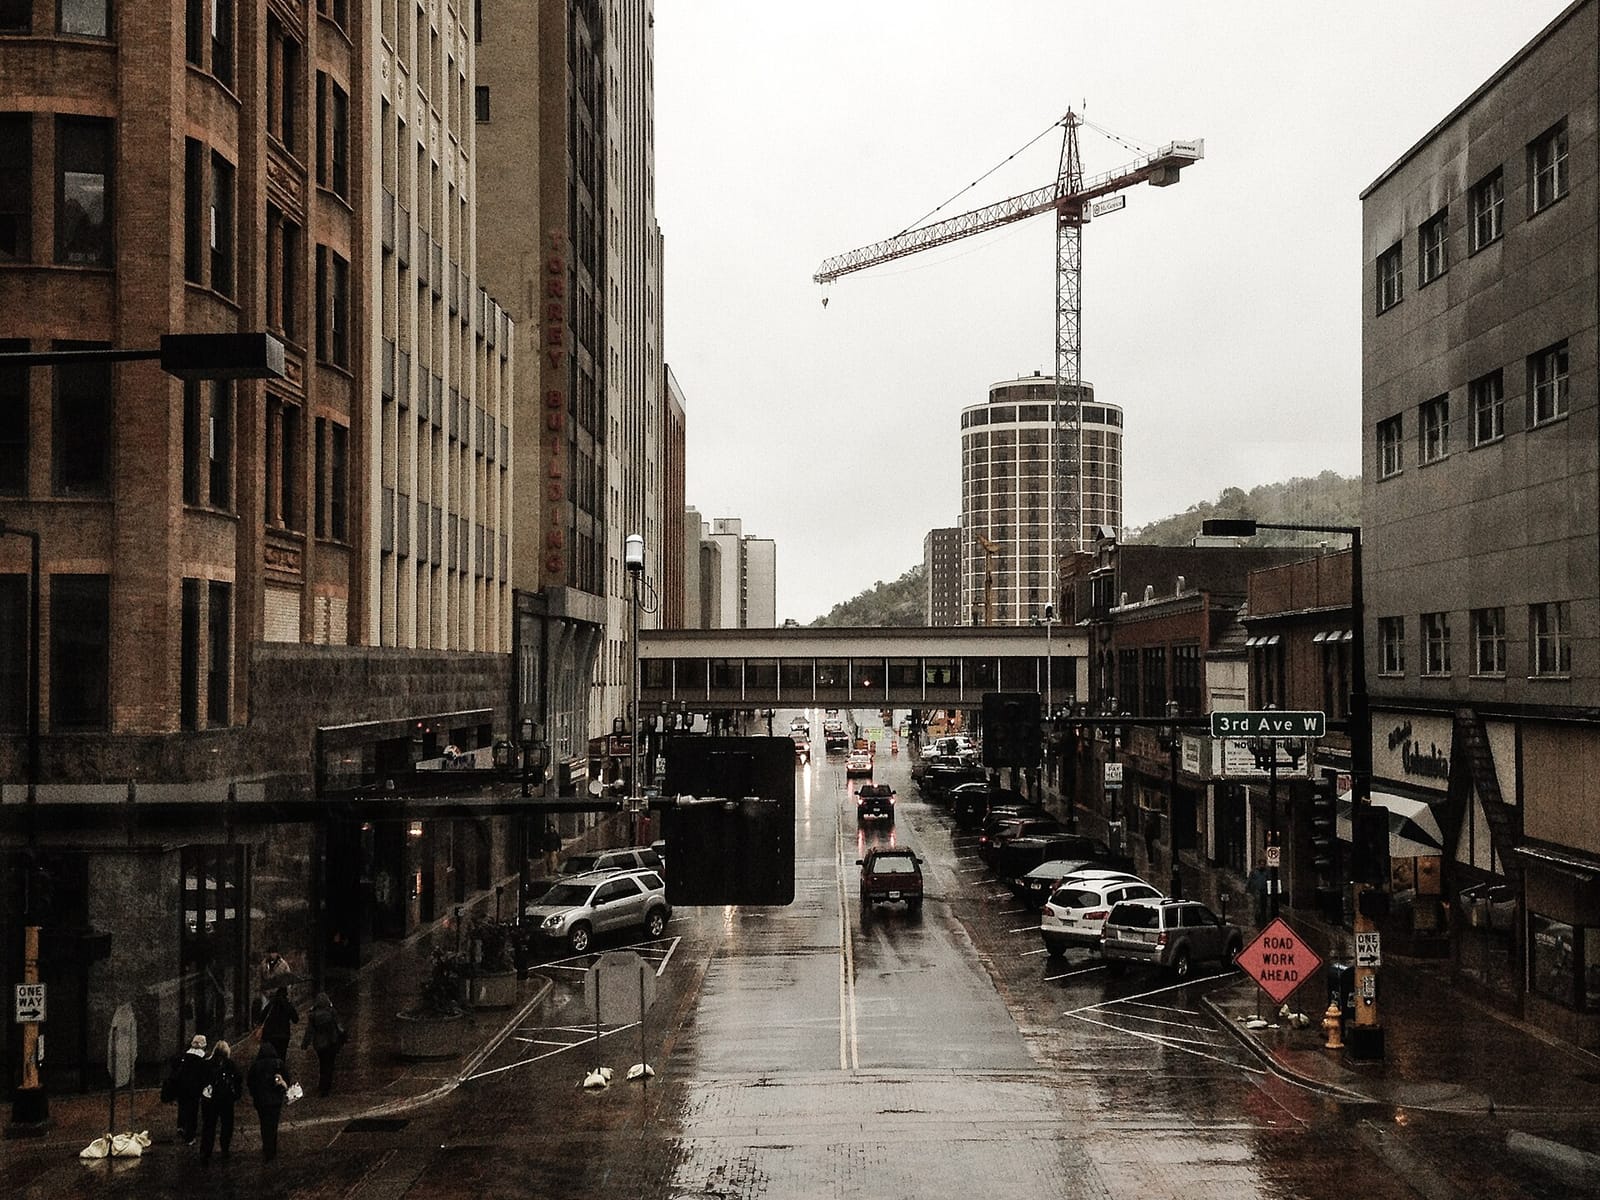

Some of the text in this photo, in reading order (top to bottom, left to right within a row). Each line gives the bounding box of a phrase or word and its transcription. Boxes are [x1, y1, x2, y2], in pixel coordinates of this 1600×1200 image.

[1219, 717, 1317, 731] 3rd Ave W
[1263, 937, 1293, 949] ROAD
[1358, 934, 1378, 944] ONE
[1358, 944, 1378, 953] WAY
[1262, 953, 1295, 966] WORK
[1260, 970, 1298, 982] AHEAD
[19, 986, 42, 997] ONE
[19, 997, 42, 1007] WAY
